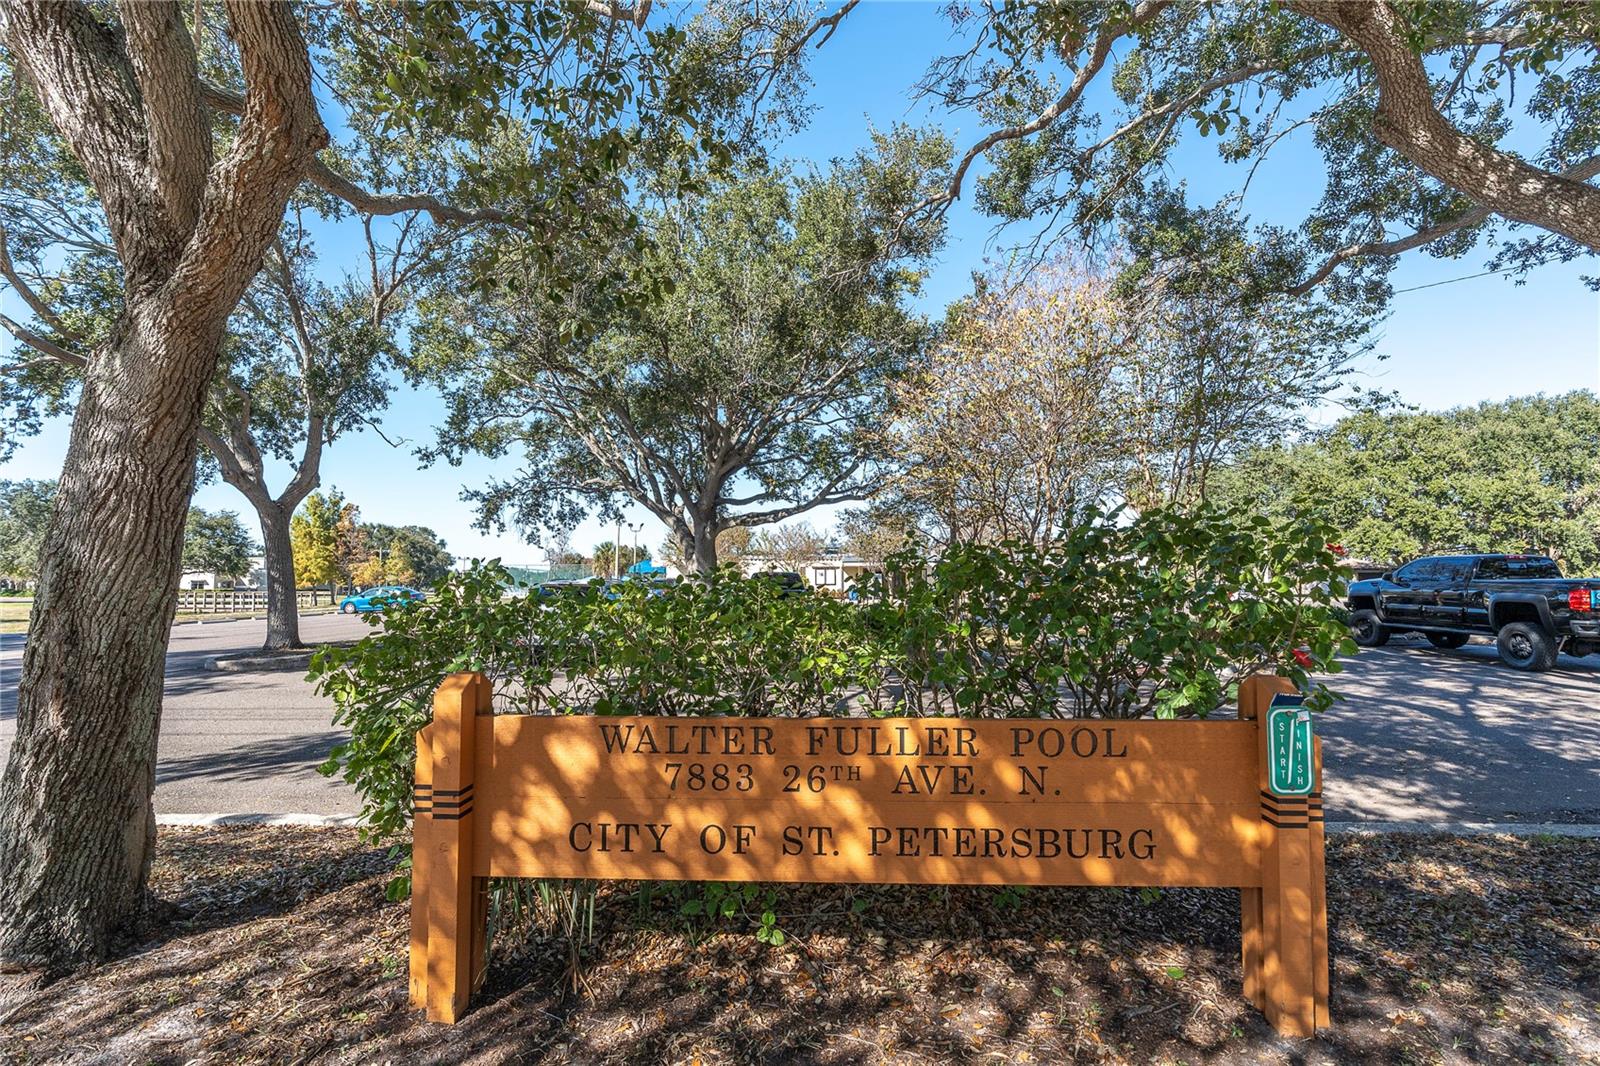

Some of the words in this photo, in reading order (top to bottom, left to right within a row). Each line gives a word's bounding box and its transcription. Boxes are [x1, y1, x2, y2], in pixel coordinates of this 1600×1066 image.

[599, 725, 776, 755] WALTER
[805, 726, 979, 757] FULLER
[1010, 728, 1127, 758] POOL
[1279, 722, 1287, 779] START
[665, 763, 753, 792] 7883
[891, 765, 986, 796] AVE.
[1018, 766, 1061, 796] N.
[569, 822, 672, 853] CITY
[700, 824, 756, 855] OF
[782, 826, 839, 857] ST.
[867, 826, 1157, 860] PETERSBURG
